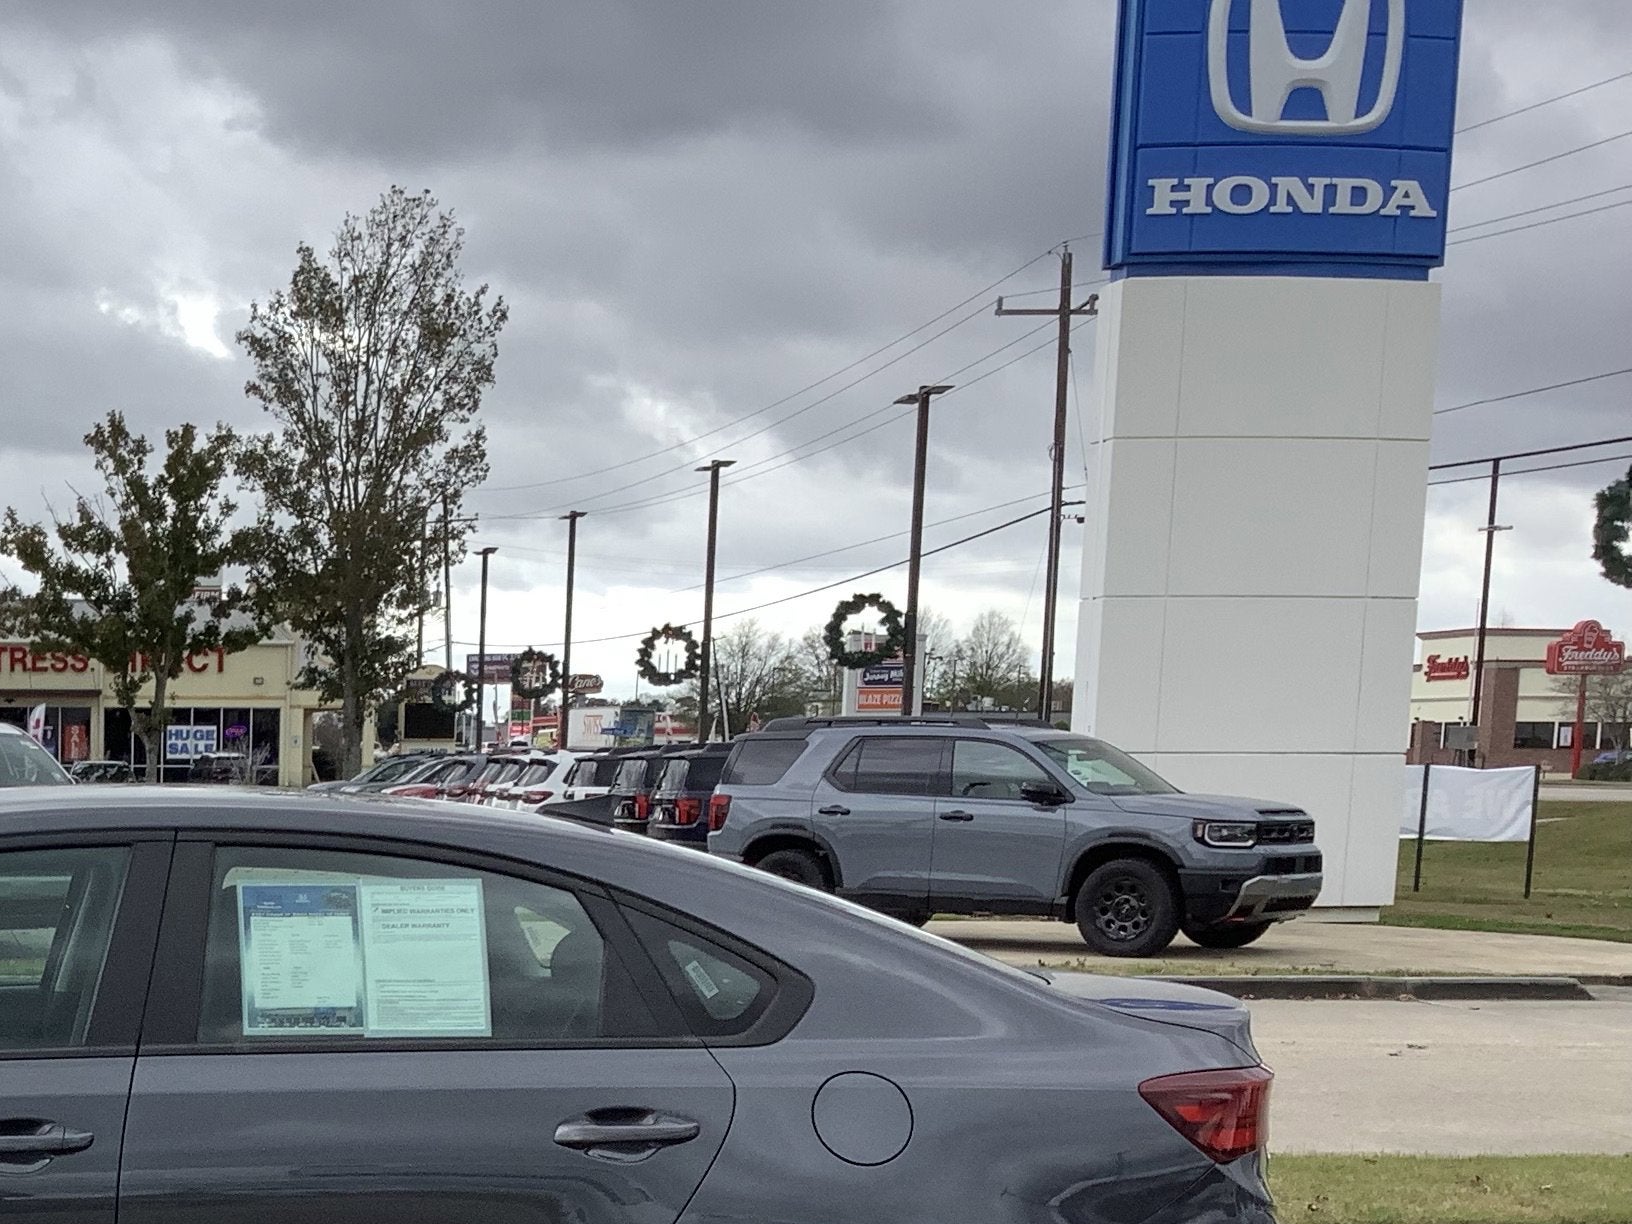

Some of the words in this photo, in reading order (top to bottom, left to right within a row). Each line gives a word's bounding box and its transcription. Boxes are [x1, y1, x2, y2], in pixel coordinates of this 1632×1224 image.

[1145, 175, 1437, 218] HONDA
[1559, 645, 1621, 663] Freddy's
[569, 674, 603, 691] Cane's
[168, 728, 215, 741] HUGE
[168, 744, 214, 754] SALE
